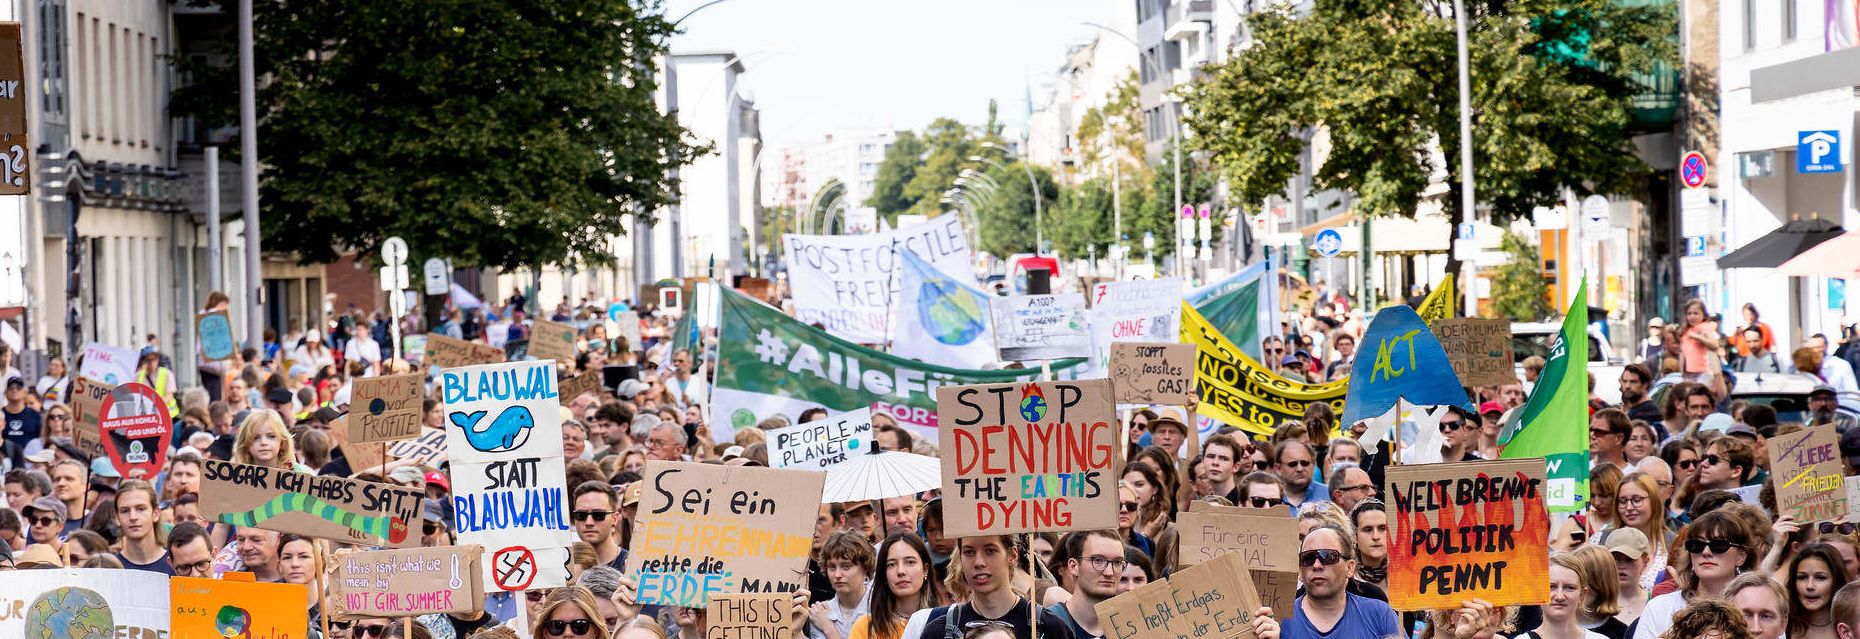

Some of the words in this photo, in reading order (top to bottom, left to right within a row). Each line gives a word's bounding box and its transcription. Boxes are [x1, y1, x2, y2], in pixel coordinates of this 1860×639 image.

[1096, 284, 1107, 304] 7
[1112, 319, 1146, 338] OHNE
[1135, 346, 1166, 358] STOPPT
[1370, 329, 1421, 384] ACT
[1142, 363, 1182, 376] fossiles
[1200, 353, 1239, 387] NO
[355, 379, 401, 400] KLIMA
[443, 365, 558, 405] BLAUWAL
[1157, 379, 1190, 396] GAS!
[386, 398, 411, 411] vor
[954, 382, 1082, 426] STOP
[1200, 379, 1244, 416] YES
[1249, 407, 1275, 428] to
[360, 413, 417, 441] PROFITE
[777, 421, 851, 450] PEOPLE
[854, 422, 871, 434] AND
[783, 438, 847, 467] PLANET
[820, 453, 848, 468] OVER
[953, 421, 1112, 476] DENYING
[1797, 443, 1836, 468] LIEBE
[204, 460, 268, 489] SOGAR
[275, 471, 304, 493] ICH
[308, 477, 356, 503] HAB'S
[484, 457, 541, 491] STATT
[955, 477, 1007, 501] THE
[1021, 468, 1101, 499] EARTH'S
[652, 469, 712, 515] Sei
[730, 491, 776, 515] ein
[1391, 479, 1453, 515] WELT
[1456, 477, 1541, 506] BRENNT
[454, 487, 569, 534] BLAUWAHL
[977, 498, 1072, 531] DYING
[1203, 525, 1231, 543] Für
[1237, 530, 1269, 546] eine
[1411, 524, 1515, 556] POLITIK
[346, 557, 371, 575] this
[376, 555, 398, 574] isn't
[399, 555, 424, 573] what
[426, 558, 441, 571] we
[641, 554, 692, 574] rette
[697, 556, 724, 574] die
[1419, 561, 1507, 595] PENNT
[345, 579, 369, 588] mean
[376, 574, 389, 591] by
[636, 574, 723, 606] ERDE
[0, 598, 25, 621] ÜR
[177, 607, 207, 616] aus
[346, 591, 370, 611] HOT
[375, 591, 402, 611] GIRL
[405, 589, 453, 611] SUMMER
[713, 598, 758, 623] THIS
[767, 598, 782, 623] IS
[1110, 613, 1137, 639] Es
[1138, 602, 1174, 632] heißt
[1171, 587, 1225, 616] Erdgas,
[1193, 621, 1209, 637] der
[1213, 608, 1251, 632] Erde
